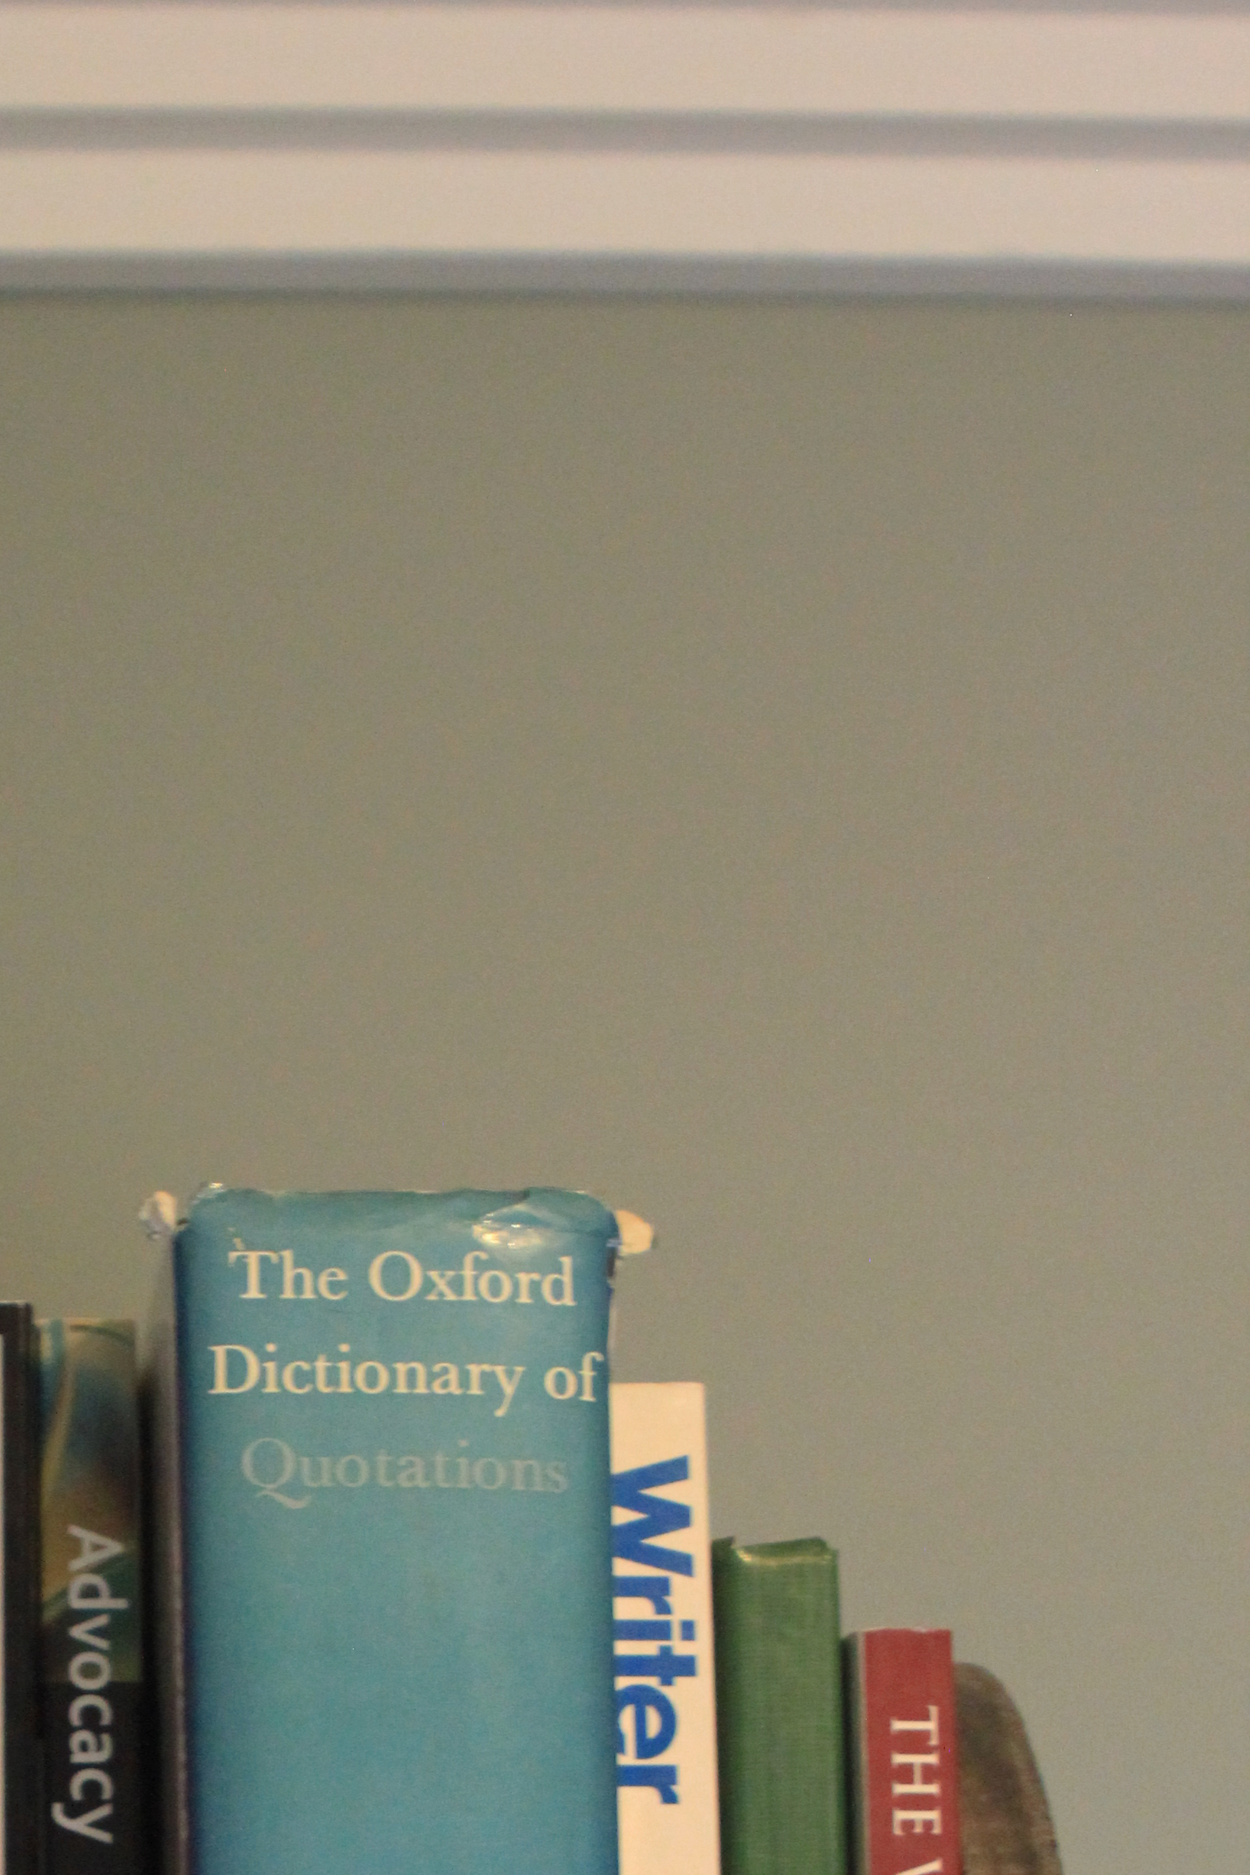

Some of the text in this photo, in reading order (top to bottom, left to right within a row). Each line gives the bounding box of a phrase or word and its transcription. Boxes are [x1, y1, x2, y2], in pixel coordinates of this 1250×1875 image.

[227, 1249, 577, 1307] The Oxford
[207, 1342, 604, 1417] Dictionary of
[241, 1437, 568, 1509] Quotations
[611, 1454, 698, 1805] Writer
[51, 1524, 129, 1844] Advocacy
[890, 1705, 943, 1837] THE
